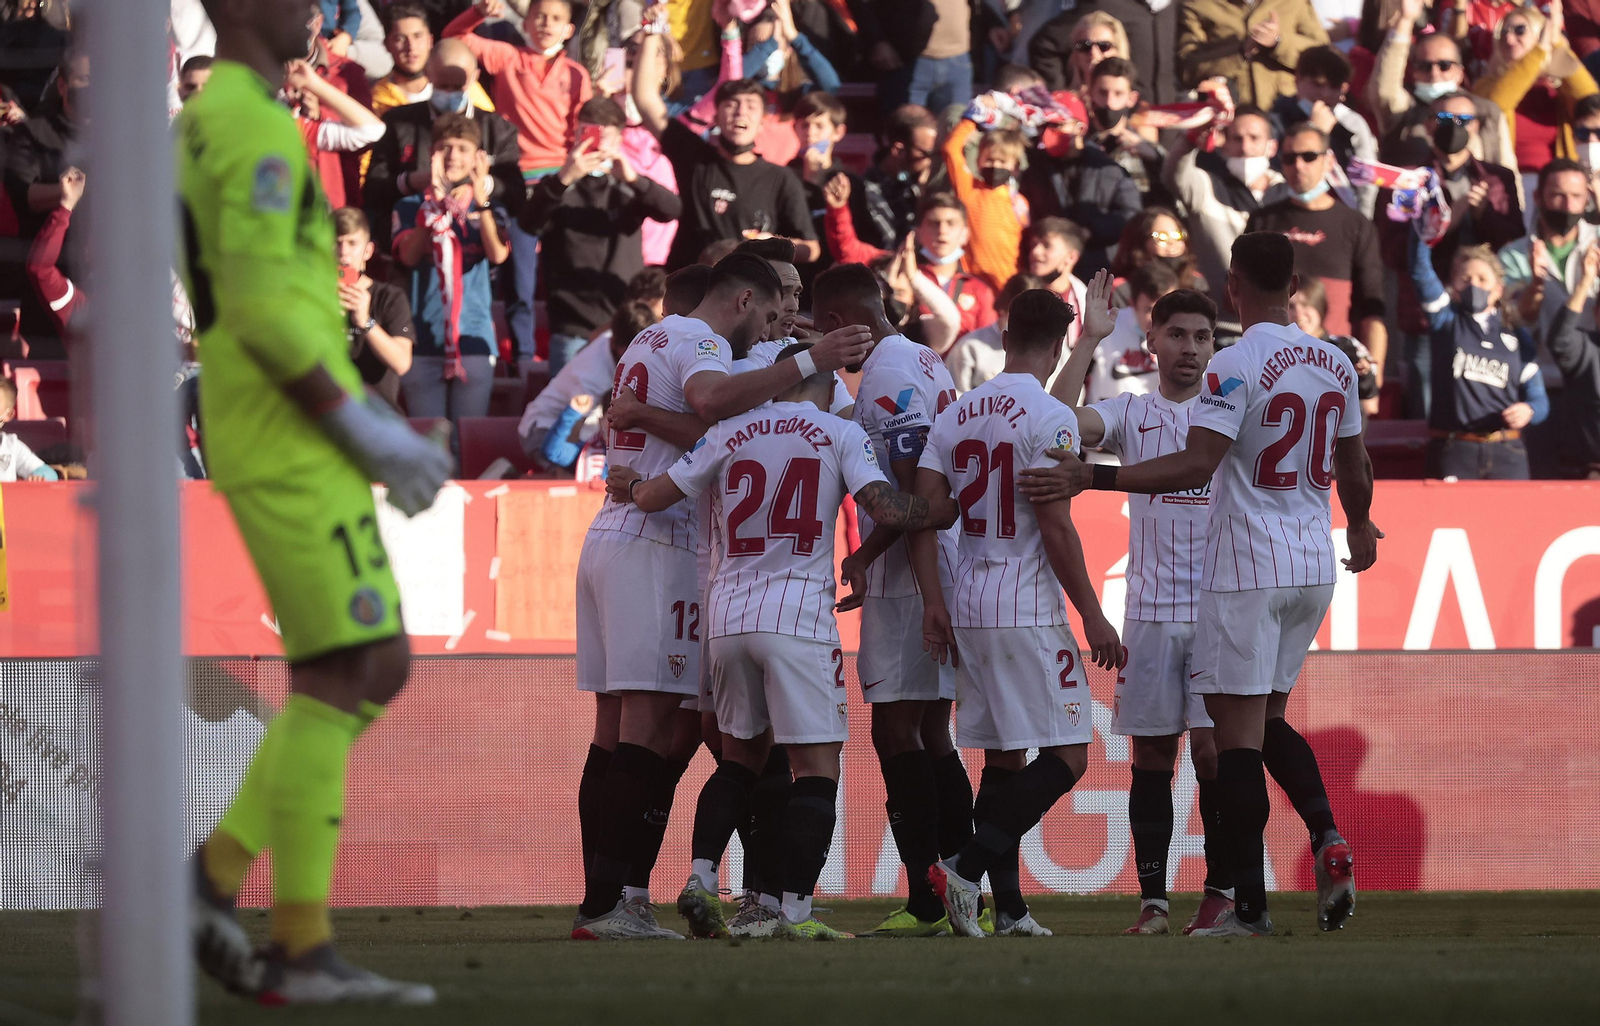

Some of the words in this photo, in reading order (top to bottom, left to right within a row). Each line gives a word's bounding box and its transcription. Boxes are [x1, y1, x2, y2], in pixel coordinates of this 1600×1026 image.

[884, 411, 923, 429] Valvoline
[1200, 396, 1237, 412] Valvoline
[725, 419, 771, 454] PAPU
[773, 415, 833, 452] GÓMEZ
[897, 433, 913, 453] C
[1252, 391, 1346, 490] 20
[725, 457, 823, 558] 24
[952, 439, 1016, 539] 21
[670, 600, 700, 643] 12
[1056, 649, 1088, 690] 2
[1140, 861, 1160, 870] SFC
